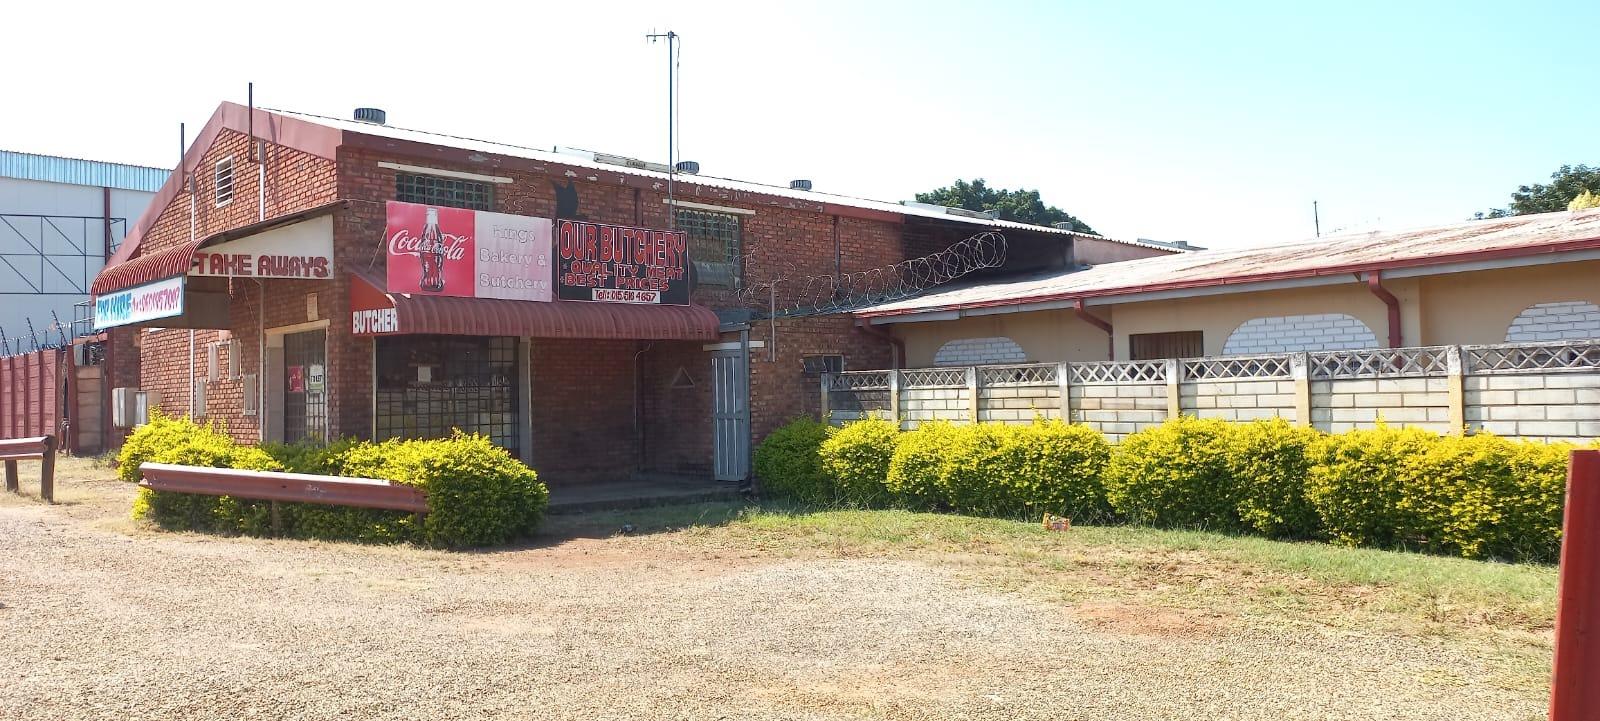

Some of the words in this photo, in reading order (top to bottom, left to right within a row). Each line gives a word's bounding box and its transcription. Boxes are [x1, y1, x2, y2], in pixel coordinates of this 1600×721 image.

[560, 221, 597, 261] OUR
[600, 226, 686, 267] BUTCHERY
[195, 253, 252, 275] TAKE
[257, 255, 329, 277] AWAYS
[480, 248, 532, 268] Bakery
[571, 260, 639, 277] QUALITY
[645, 265, 684, 280] MEAT
[480, 273, 547, 293] Butchery
[564, 272, 608, 288] BEST
[615, 276, 669, 291] PRICES
[352, 308, 399, 334] BUTCHER
